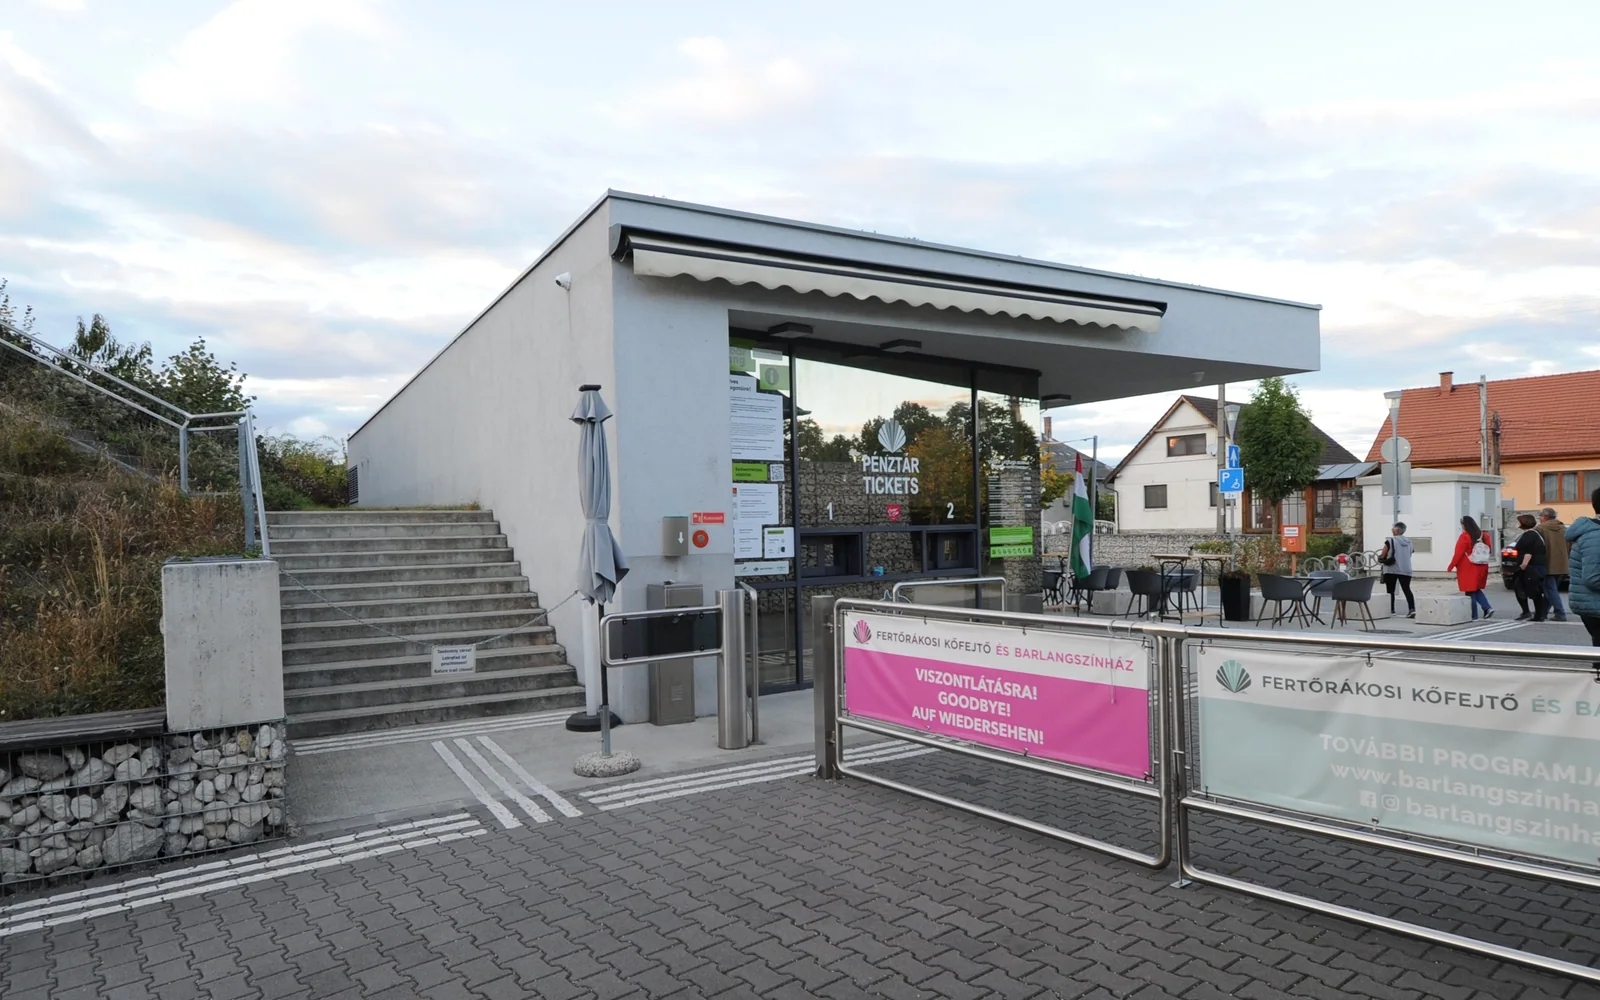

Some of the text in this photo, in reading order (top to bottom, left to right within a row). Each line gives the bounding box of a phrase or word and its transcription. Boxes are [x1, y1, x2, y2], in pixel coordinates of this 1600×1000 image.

[863, 451, 919, 473] PÉNZTÁR
[863, 476, 919, 494] TICKETS
[1222, 472, 1230, 483] P
[826, 502, 955, 520] 1 2
[876, 631, 1134, 672] FERTŐRÁKOSI KŐFEJTŐ ÉS BARLANGSZÍNHÁZ
[915, 668, 1037, 700] VISZONTLÁTÁSRA!
[1262, 676, 1402, 700] FERTŐRÁKOSI
[1412, 686, 1519, 711] KŐFEJTŐ
[1532, 695, 1561, 714] ÉS
[938, 691, 1011, 717] GOODBYE!
[912, 706, 1044, 745] AUF WIEDERSEHEN!
[1319, 733, 1424, 764] TOVÁBBI
